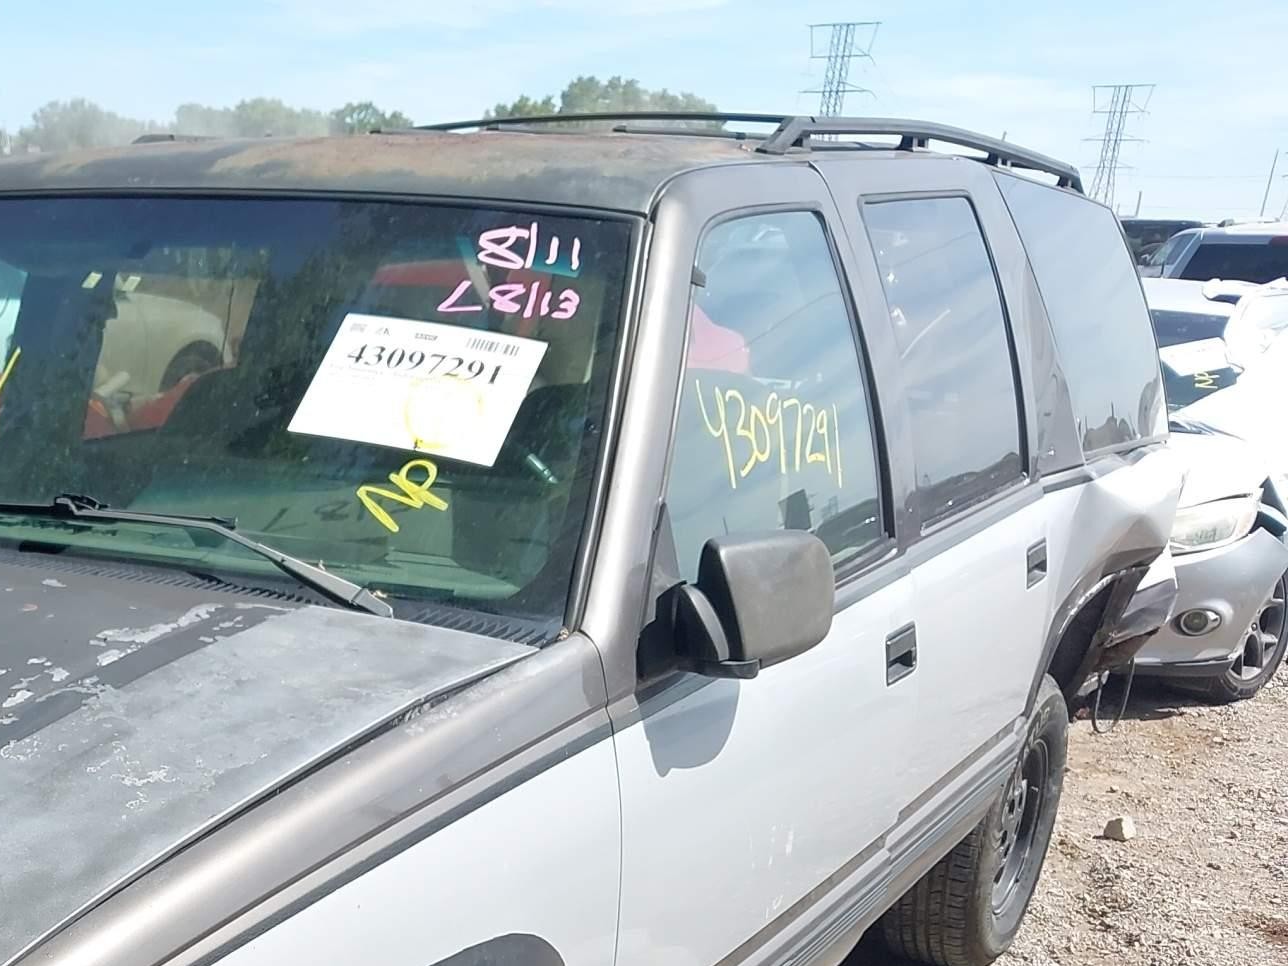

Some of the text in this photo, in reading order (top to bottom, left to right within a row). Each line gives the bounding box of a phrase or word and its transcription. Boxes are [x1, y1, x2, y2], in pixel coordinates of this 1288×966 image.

[477, 222, 582, 270] 8/11
[347, 344, 504, 385] 43097291
[695, 378, 843, 490] 43097291
[356, 459, 449, 533] NP
